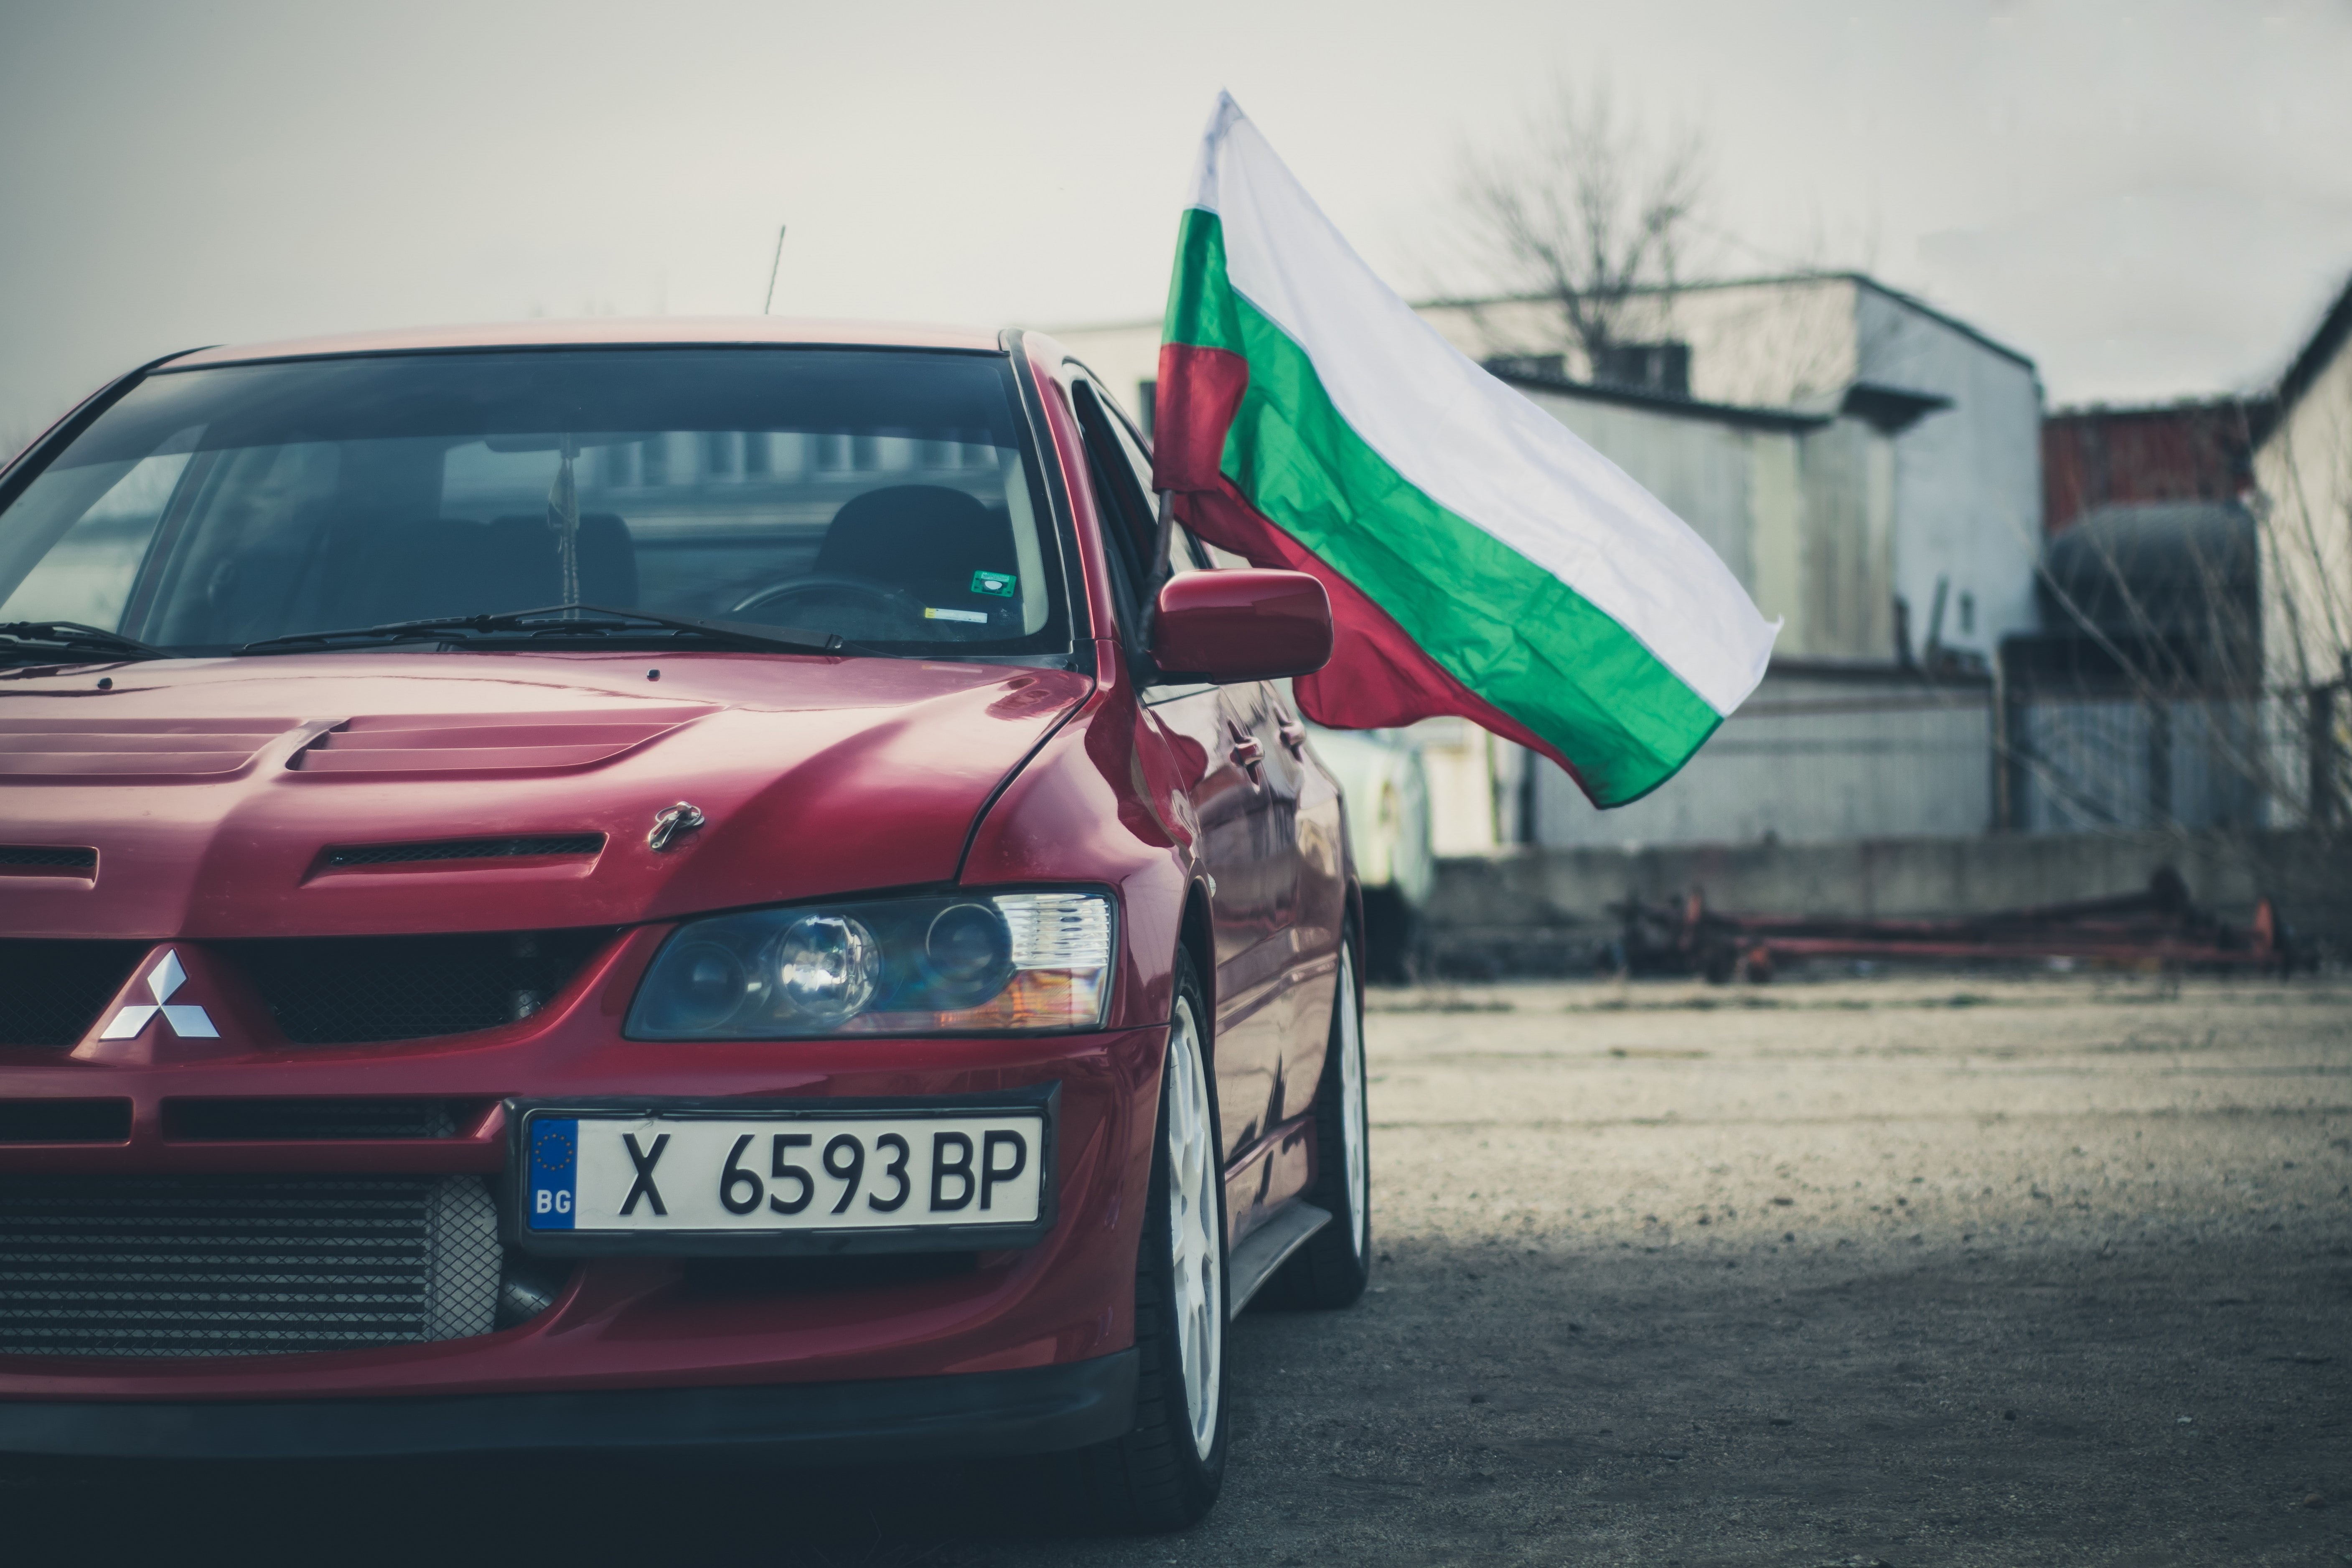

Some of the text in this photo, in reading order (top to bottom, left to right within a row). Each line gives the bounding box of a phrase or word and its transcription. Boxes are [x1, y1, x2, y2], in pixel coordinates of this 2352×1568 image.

[618, 1129, 1027, 1217] X 6593 BP
[536, 1189, 571, 1214] BG
